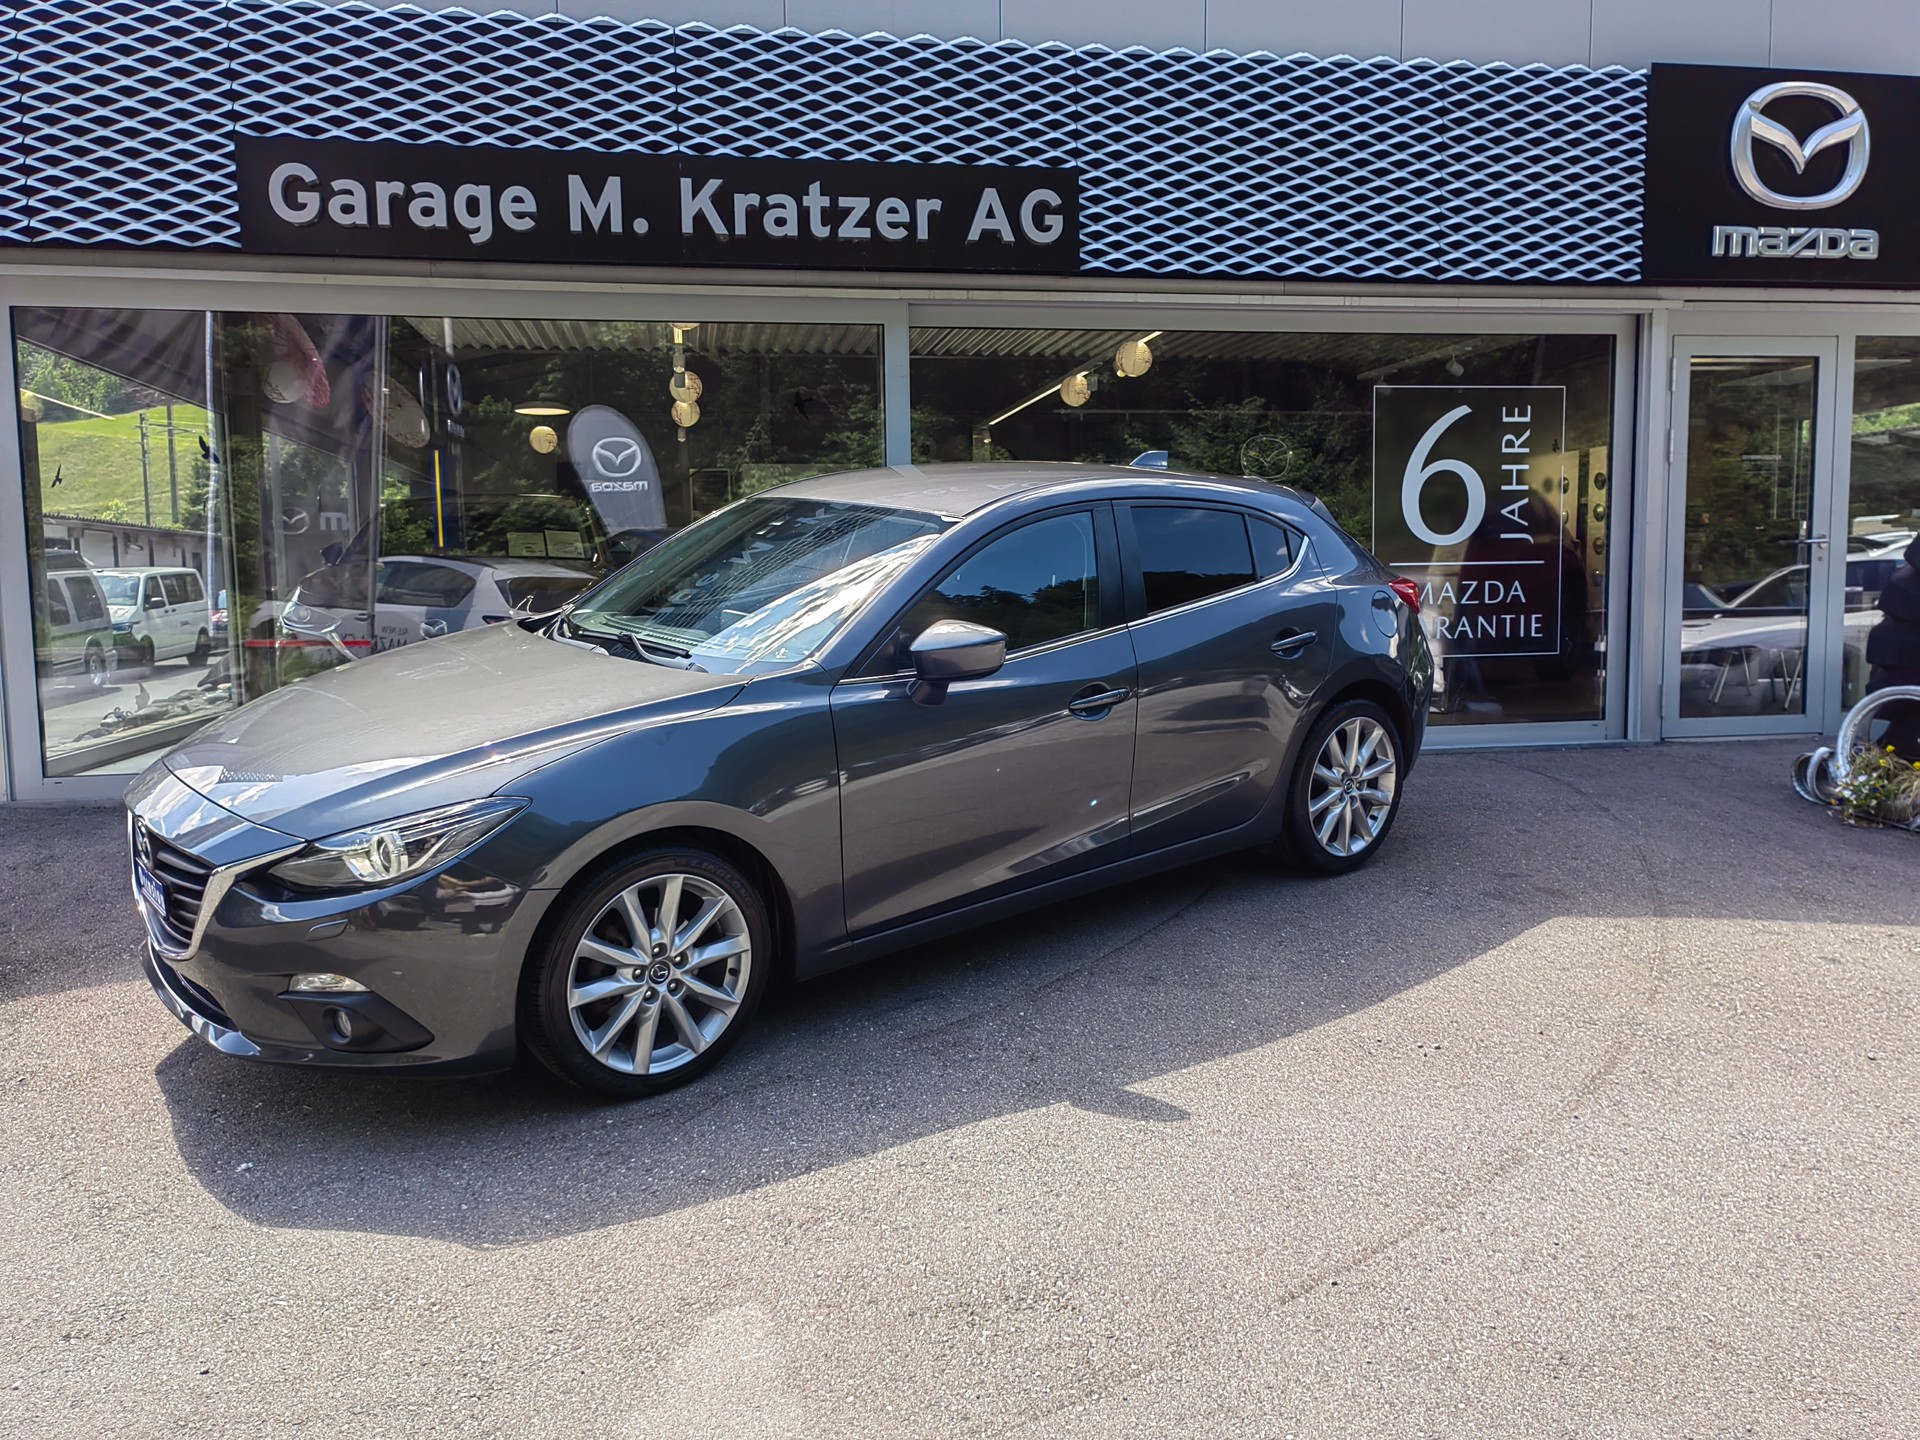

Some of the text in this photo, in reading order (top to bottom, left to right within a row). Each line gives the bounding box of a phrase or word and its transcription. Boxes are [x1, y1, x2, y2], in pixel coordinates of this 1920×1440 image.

[267, 161, 1064, 245] Garage M. Kratzer AG
[1401, 404, 1486, 546] 6
[1500, 404, 1534, 544] JAHRE
[1419, 613, 1543, 640] RANTIE
